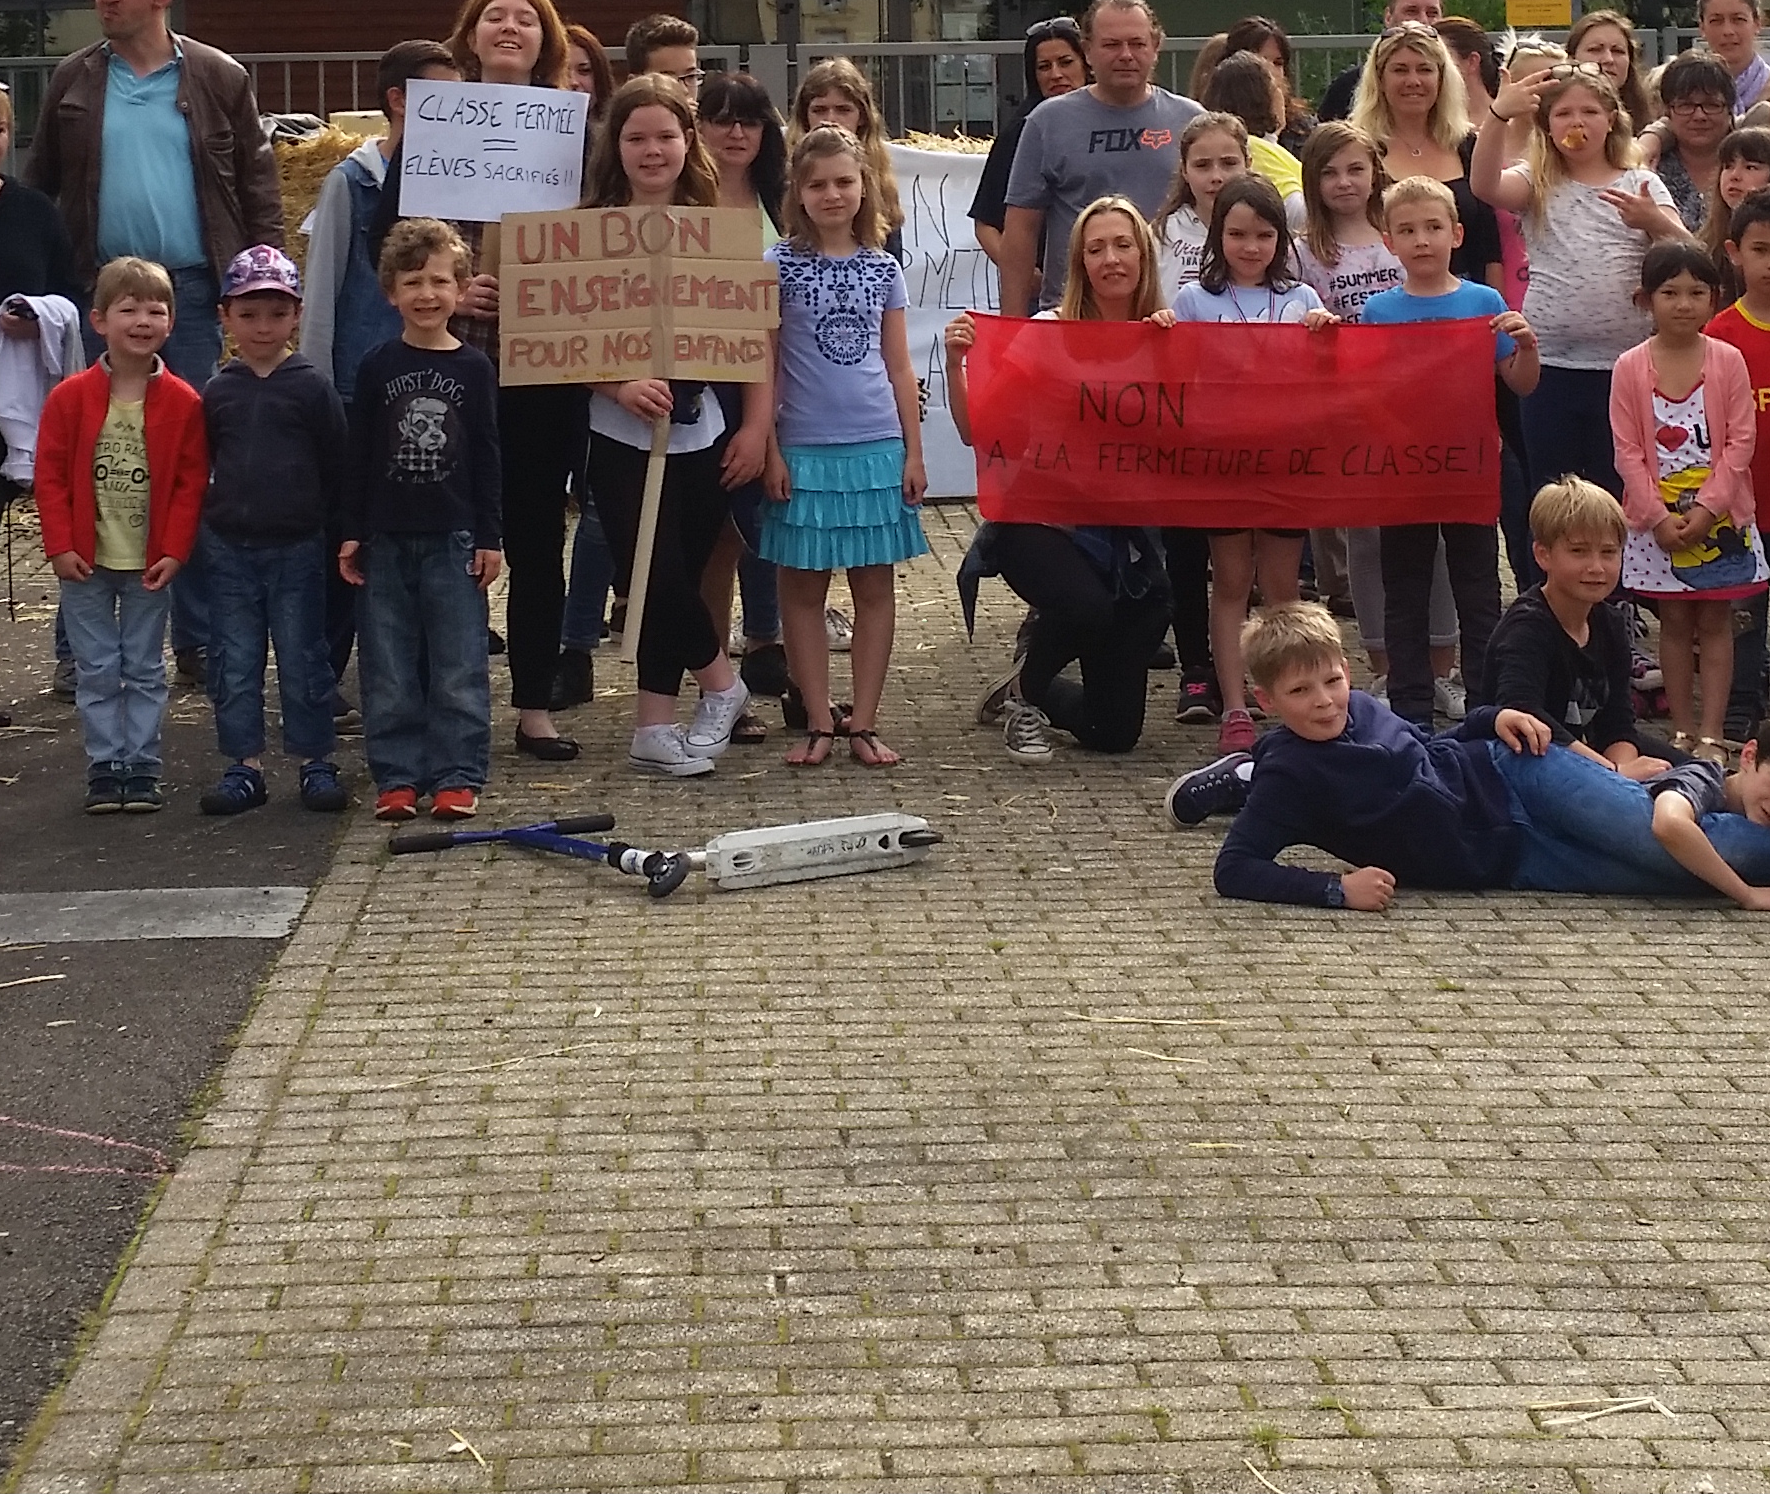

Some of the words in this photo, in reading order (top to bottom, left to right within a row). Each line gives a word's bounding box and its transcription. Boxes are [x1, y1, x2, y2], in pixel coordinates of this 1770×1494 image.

[418, 94, 503, 127] CLASSE
[515, 102, 576, 134] FERMÉE
[1089, 127, 1144, 153] FOX
[483, 162, 559, 186] SACRIFIÉS
[516, 221, 581, 265] UN
[600, 210, 711, 255] BON
[1329, 268, 1399, 292] #SUMMER
[508, 335, 589, 370] POUR
[1079, 381, 1186, 429] NON
[986, 440, 1007, 469] A
[1034, 442, 1071, 472] LA
[1098, 443, 1269, 477] FERMETURE
[1289, 446, 1327, 477] DE
